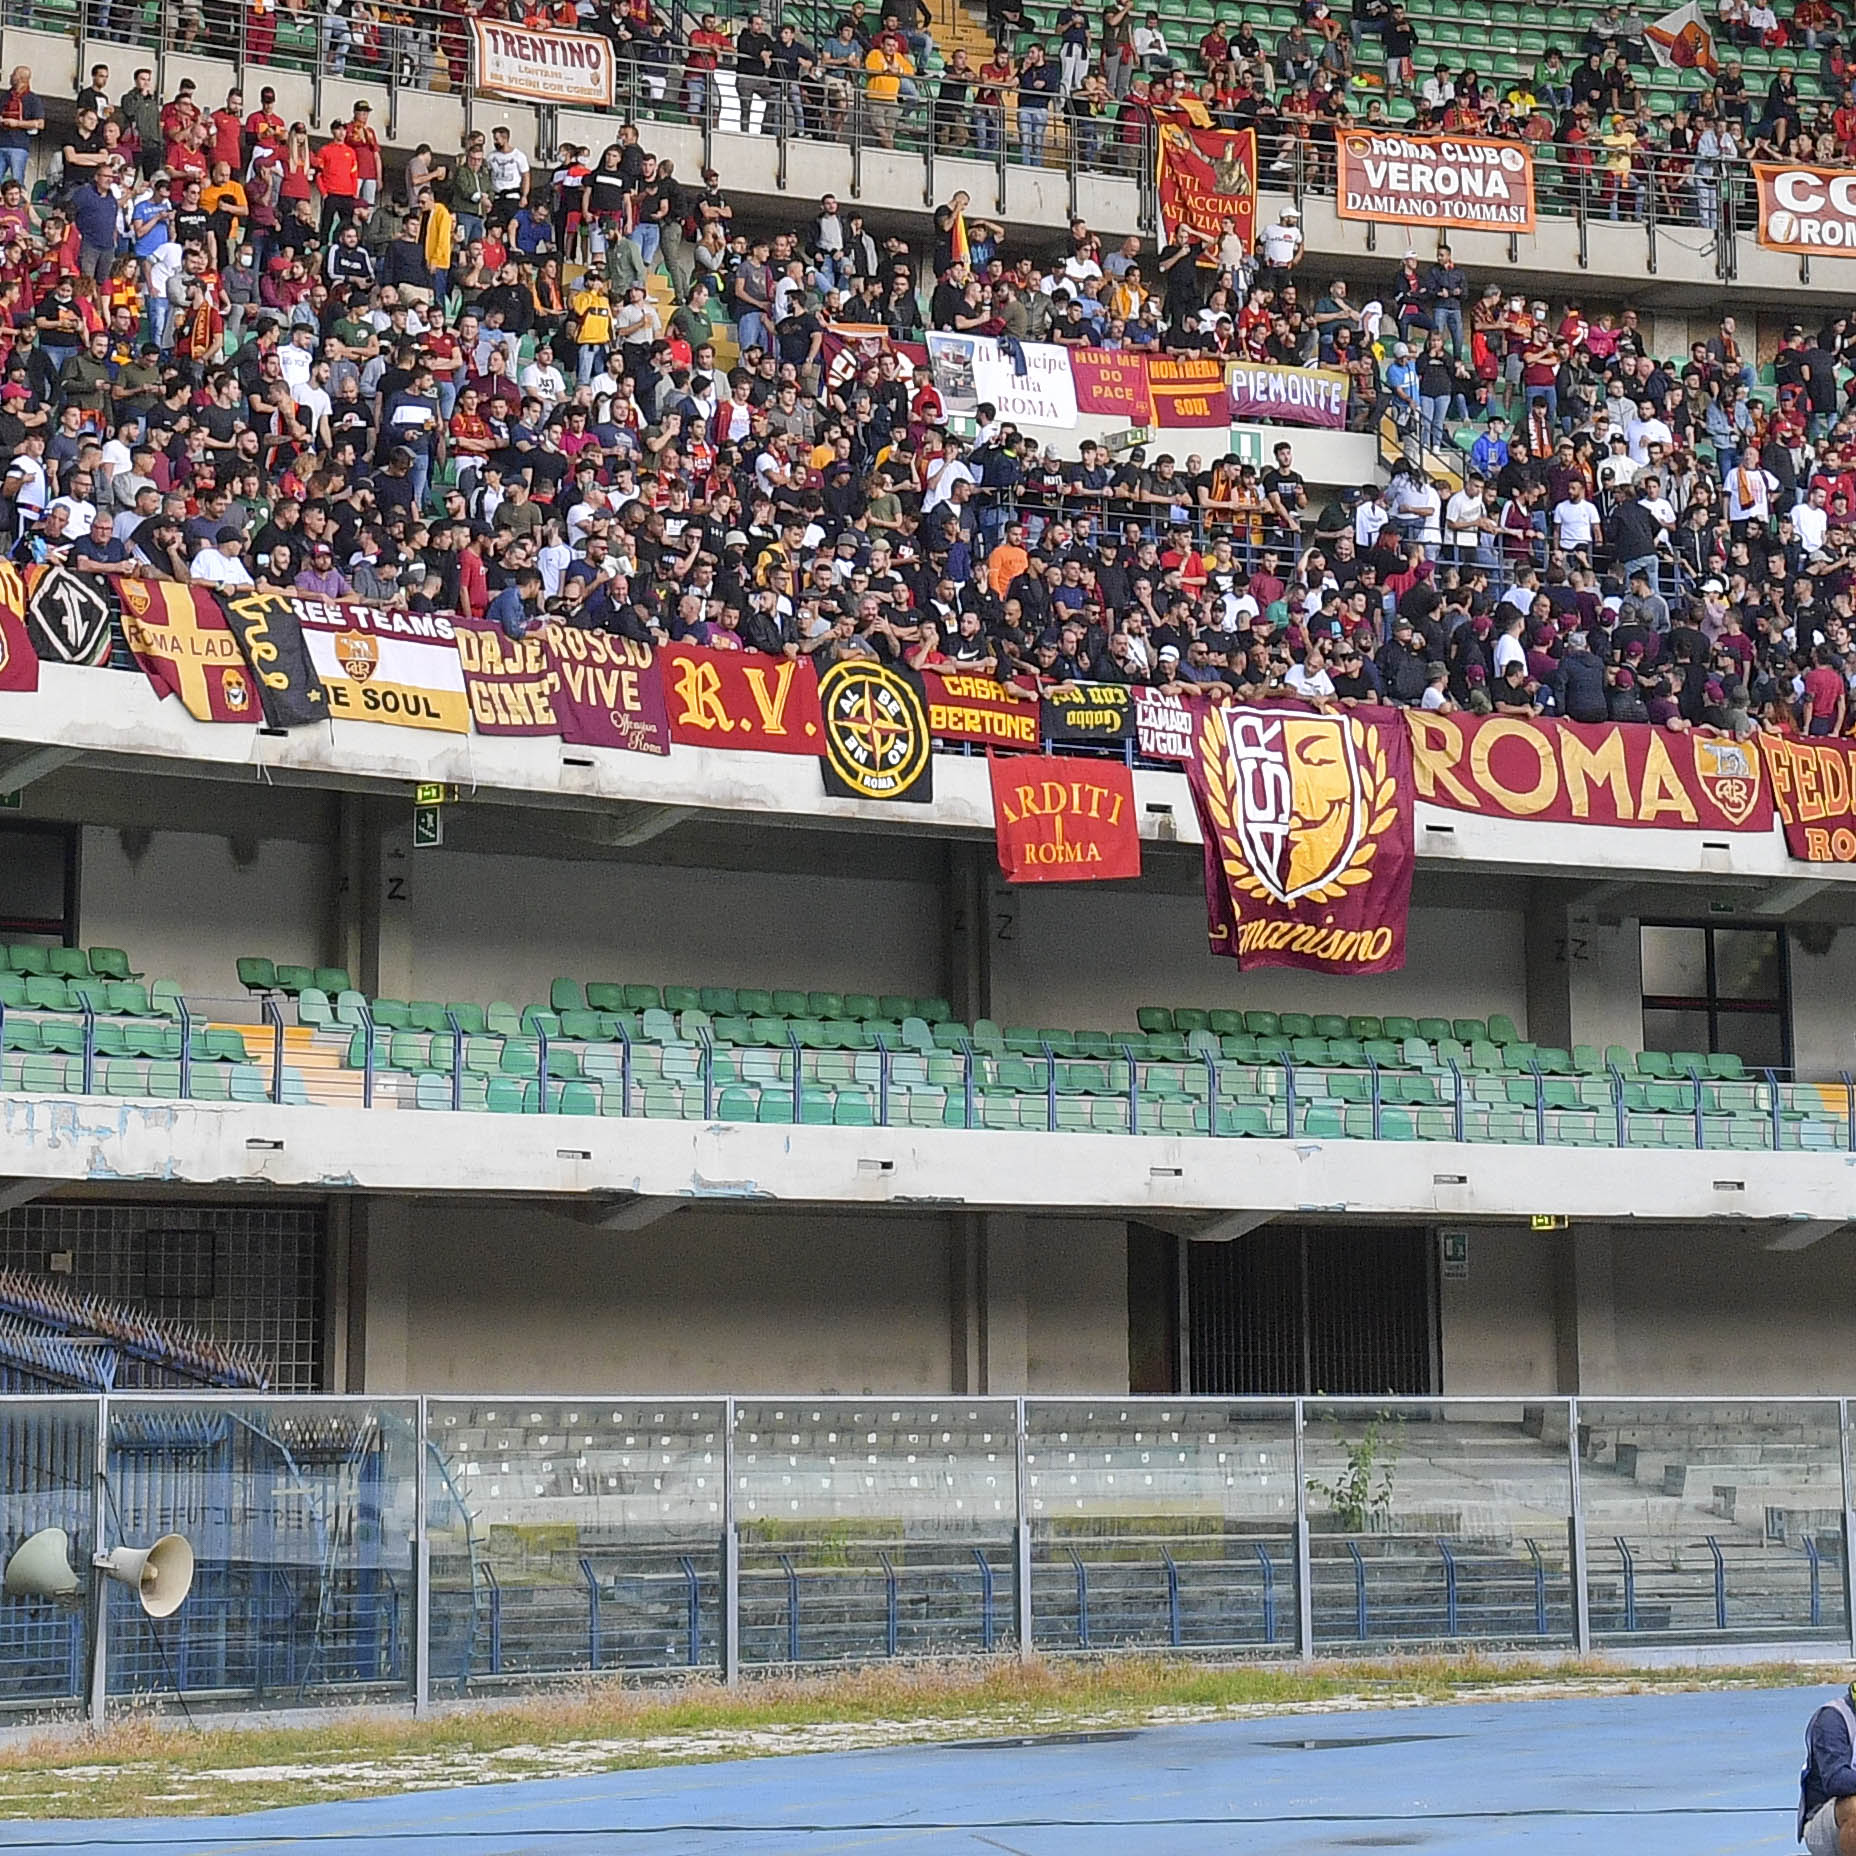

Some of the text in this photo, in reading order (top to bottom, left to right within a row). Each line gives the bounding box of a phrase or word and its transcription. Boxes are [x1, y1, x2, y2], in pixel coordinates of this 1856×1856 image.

[486, 29, 601, 69] TRENTINO
[1371, 136, 1501, 165] ROMA CLUB
[1363, 160, 1510, 198] VERONA
[1347, 192, 1526, 223] DAMIANO TOMMASI
[1075, 351, 1140, 368] NUN ME
[1150, 360, 1220, 378] NORTHERN
[1100, 369, 1122, 382] DO
[1092, 385, 1133, 400] PACE
[1173, 398, 1211, 416] SOUL
[1231, 370, 1342, 415] PIEMONTE
[997, 398, 1058, 418] ROMA
[350, 604, 456, 641] TEAMS
[128, 623, 184, 655] ROMA
[454, 627, 546, 675] DAJE
[546, 624, 652, 670] ROSCIO
[562, 664, 642, 712] VIVE
[363, 688, 441, 720] SOUL
[929, 704, 1035, 742] BERTONE
[1156, 731, 1194, 759] GOLA
[1403, 709, 1698, 823] ROMA
[863, 775, 895, 789] ROMA
[1232, 716, 1293, 893] ASR
[1025, 842, 1102, 864] ROMA
[387, 878, 406, 901] Z
[997, 914, 1012, 940] Z
[1573, 938, 1588, 961] Z
